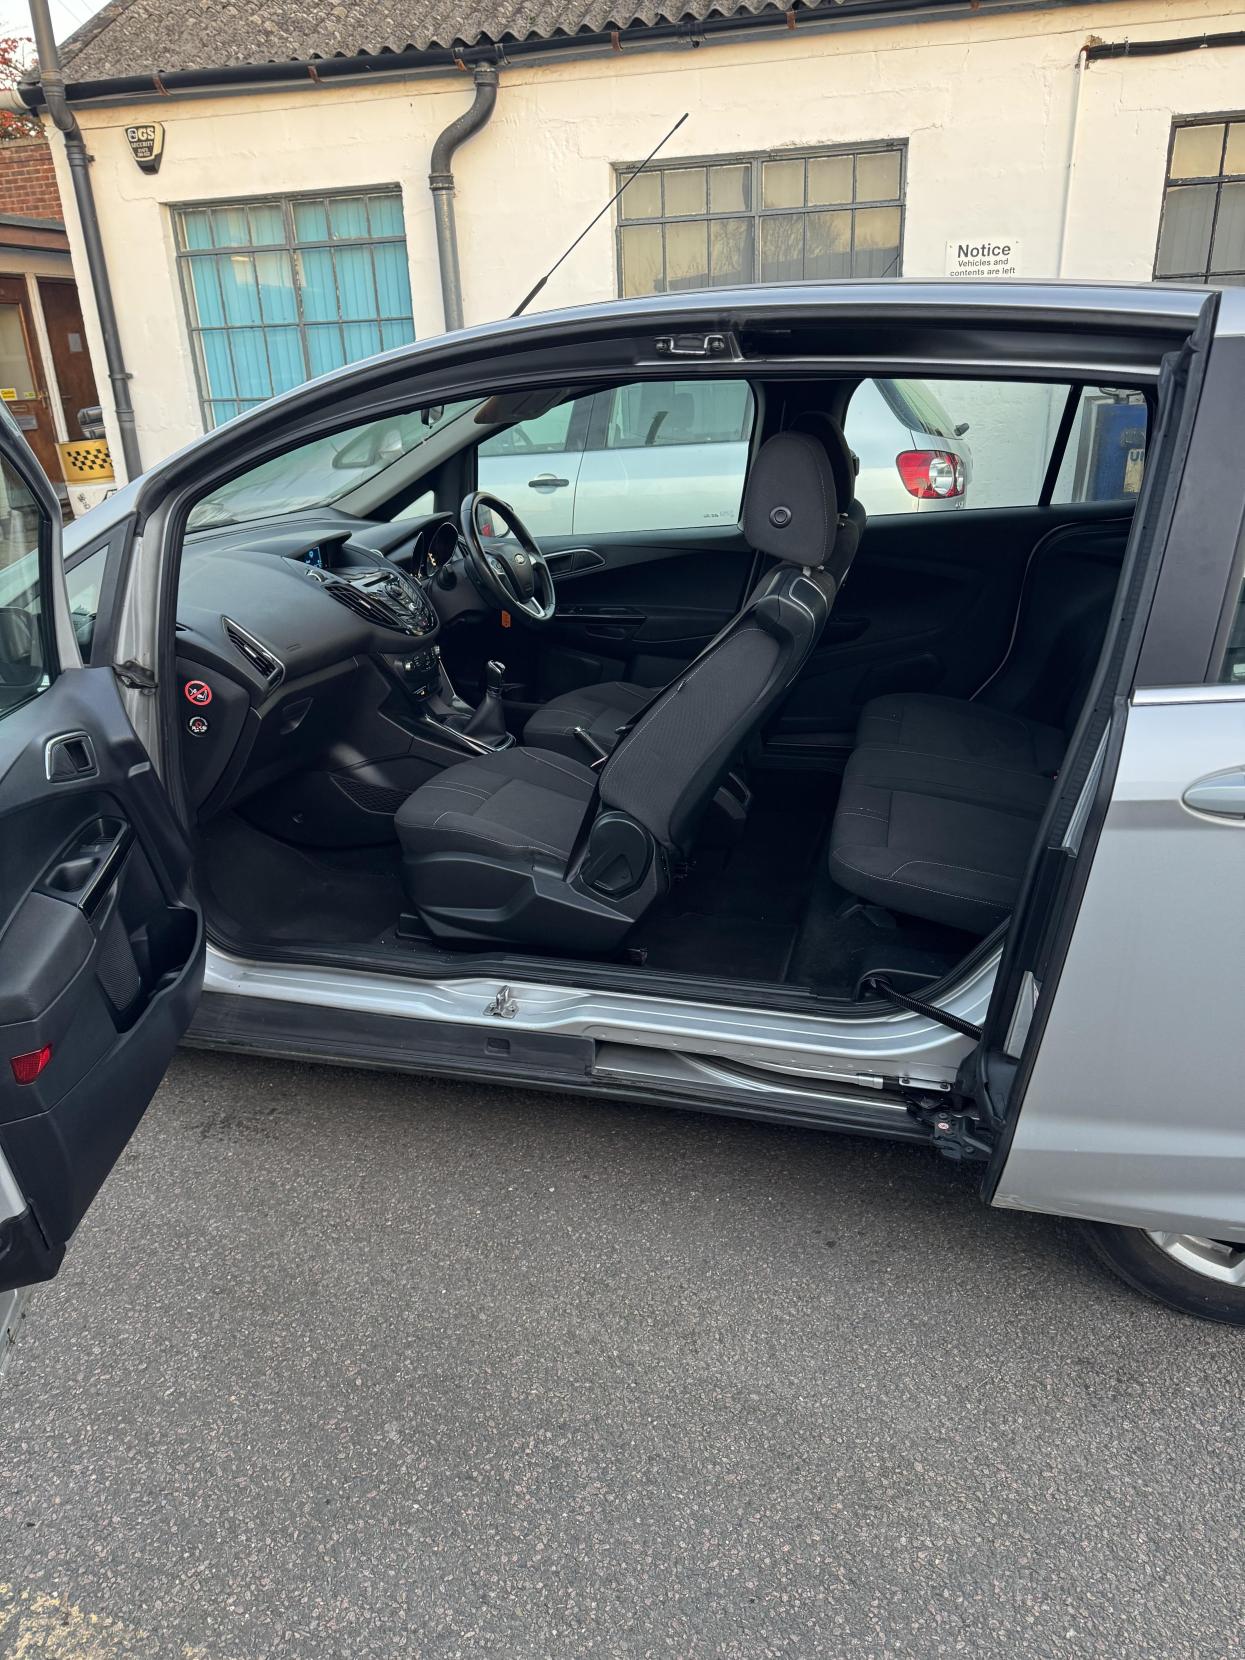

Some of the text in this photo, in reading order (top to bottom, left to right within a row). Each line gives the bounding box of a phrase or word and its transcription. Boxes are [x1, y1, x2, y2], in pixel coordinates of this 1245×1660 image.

[957, 243, 1011, 258] Notice
[958, 258, 1009, 267] Vehicles and
[950, 269, 985, 277] contents
[1002, 266, 1016, 274] left
